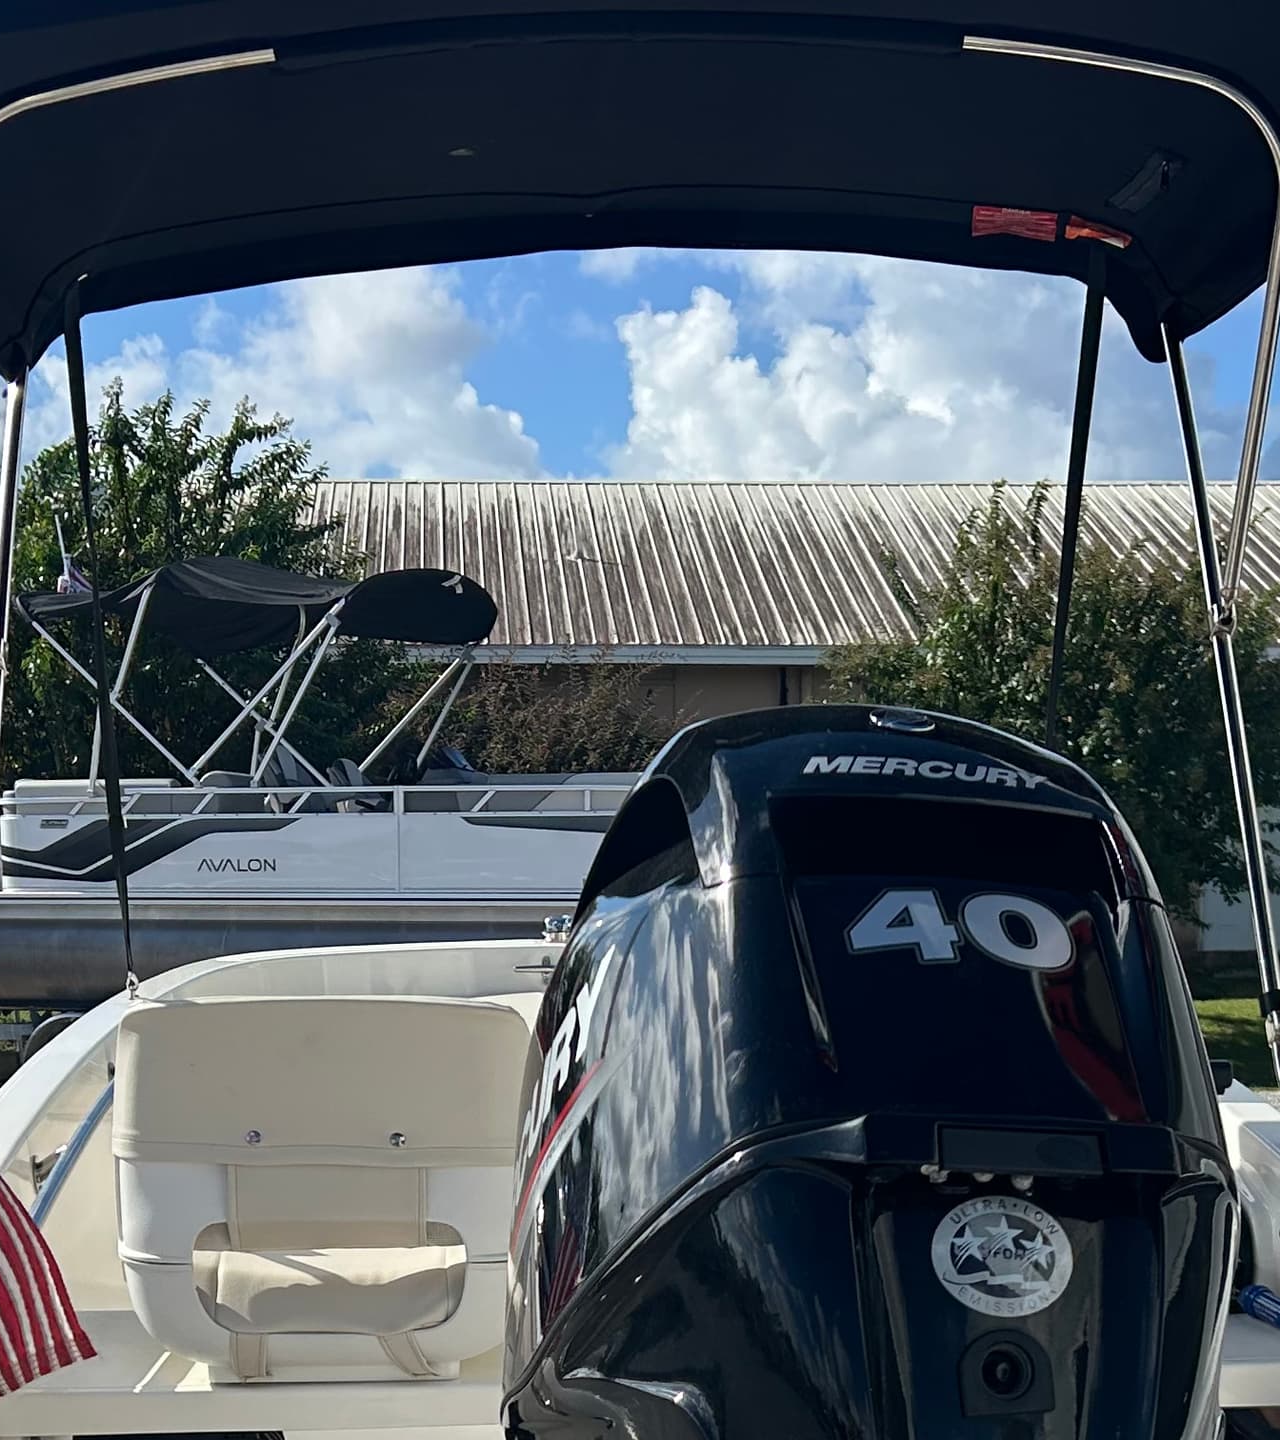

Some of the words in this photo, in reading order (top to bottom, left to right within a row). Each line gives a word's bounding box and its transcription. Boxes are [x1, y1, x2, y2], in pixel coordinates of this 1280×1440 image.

[802, 755, 1050, 789] MERCURY
[197, 858, 277, 873] AVALON
[844, 887, 1075, 972] 40
[949, 1199, 1008, 1225] ULTRA
[1023, 1203, 1060, 1236] LOW
